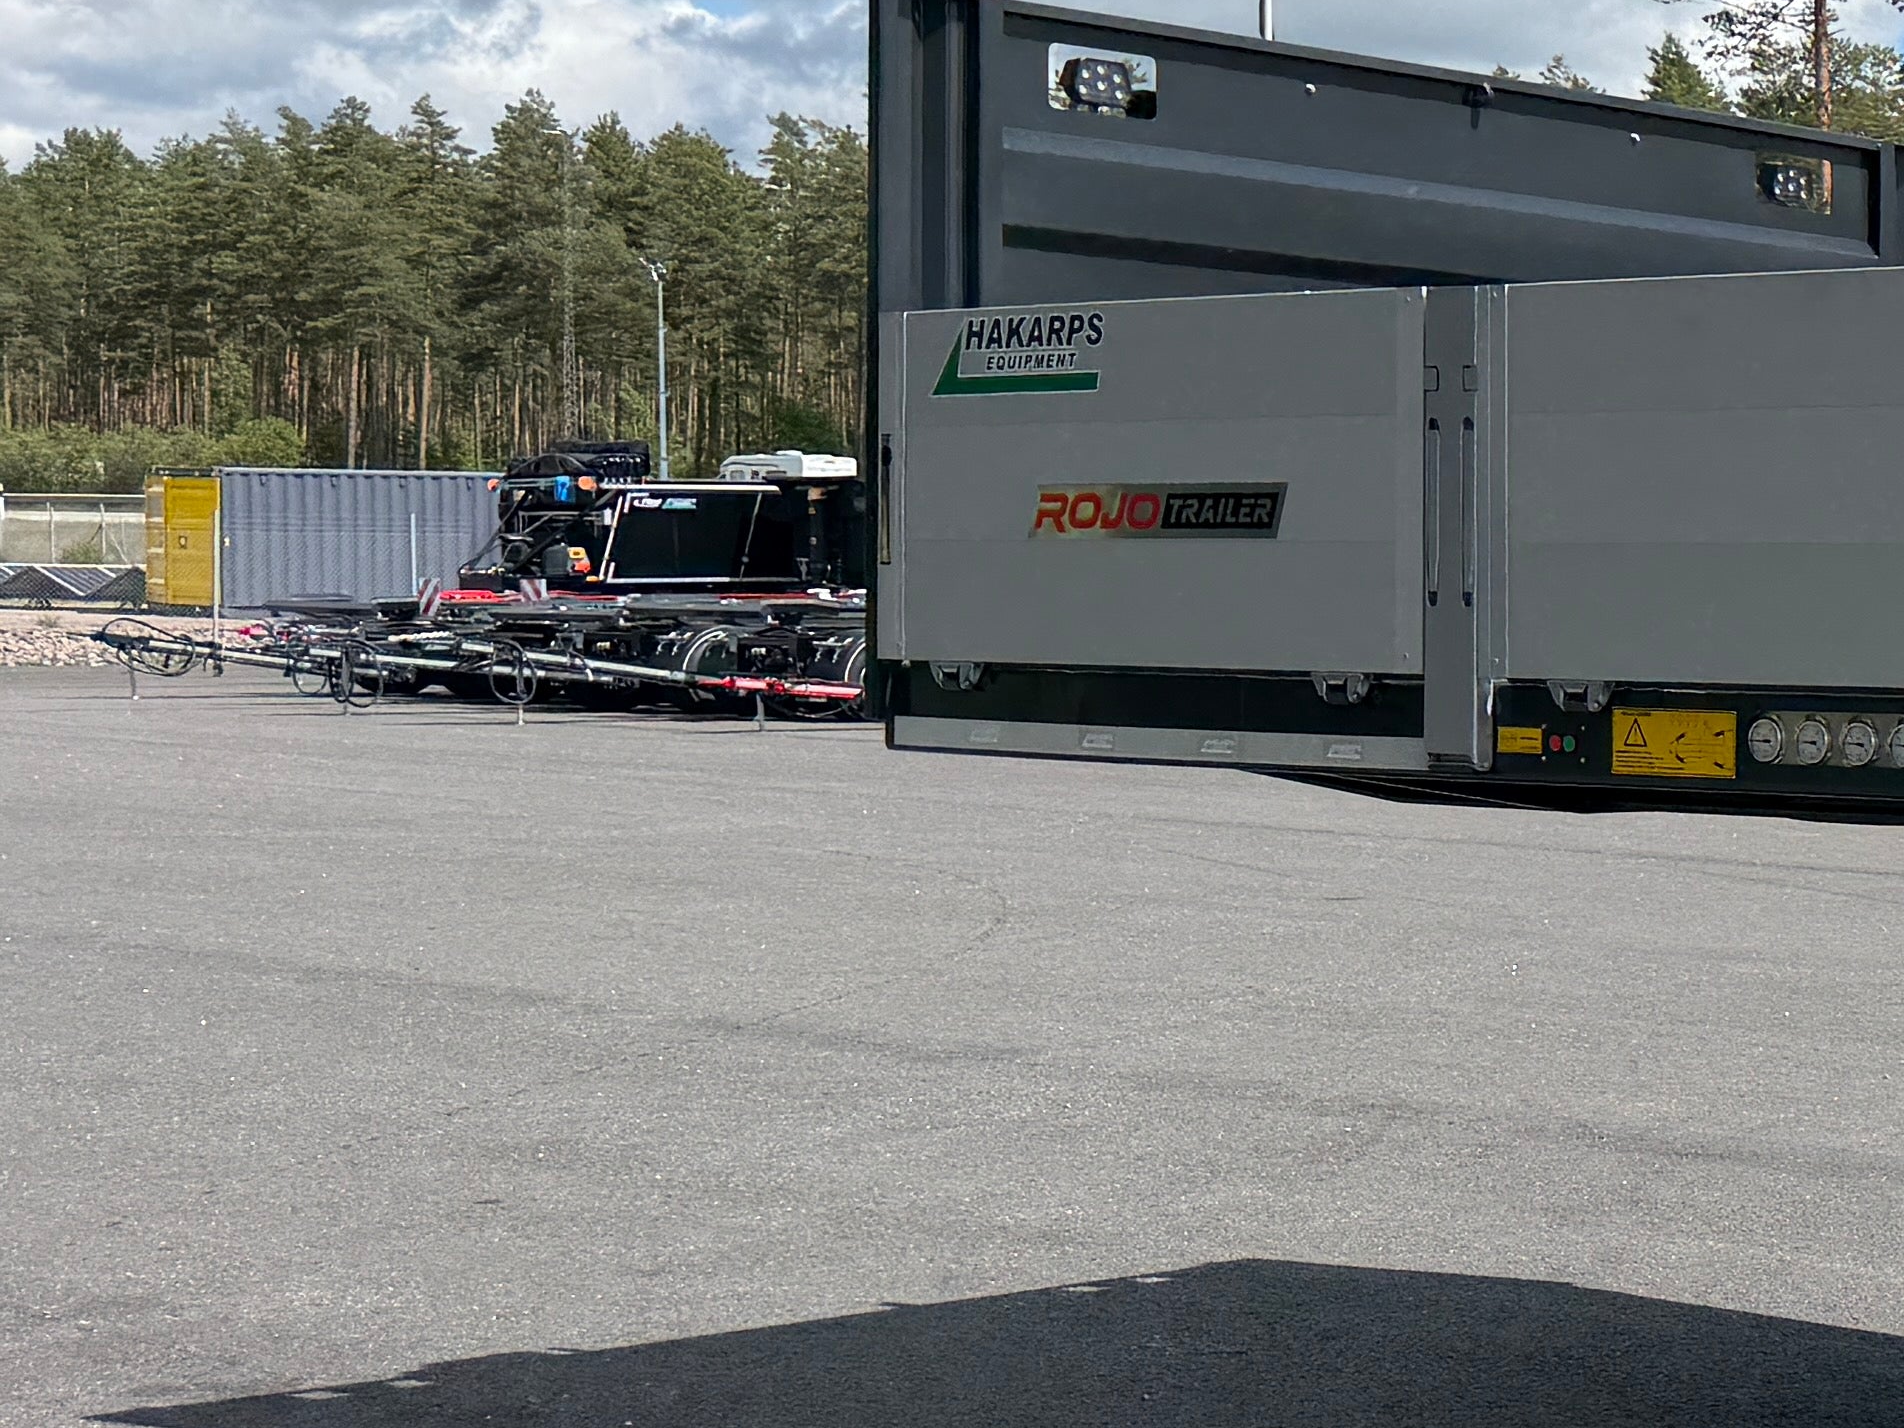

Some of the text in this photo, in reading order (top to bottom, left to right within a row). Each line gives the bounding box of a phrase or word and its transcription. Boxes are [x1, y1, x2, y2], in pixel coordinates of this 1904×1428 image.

[965, 313, 1103, 350] HAKARPS
[987, 353, 1077, 370] EQUIPMENT
[1035, 492, 1273, 533] ROJO TRAILER
